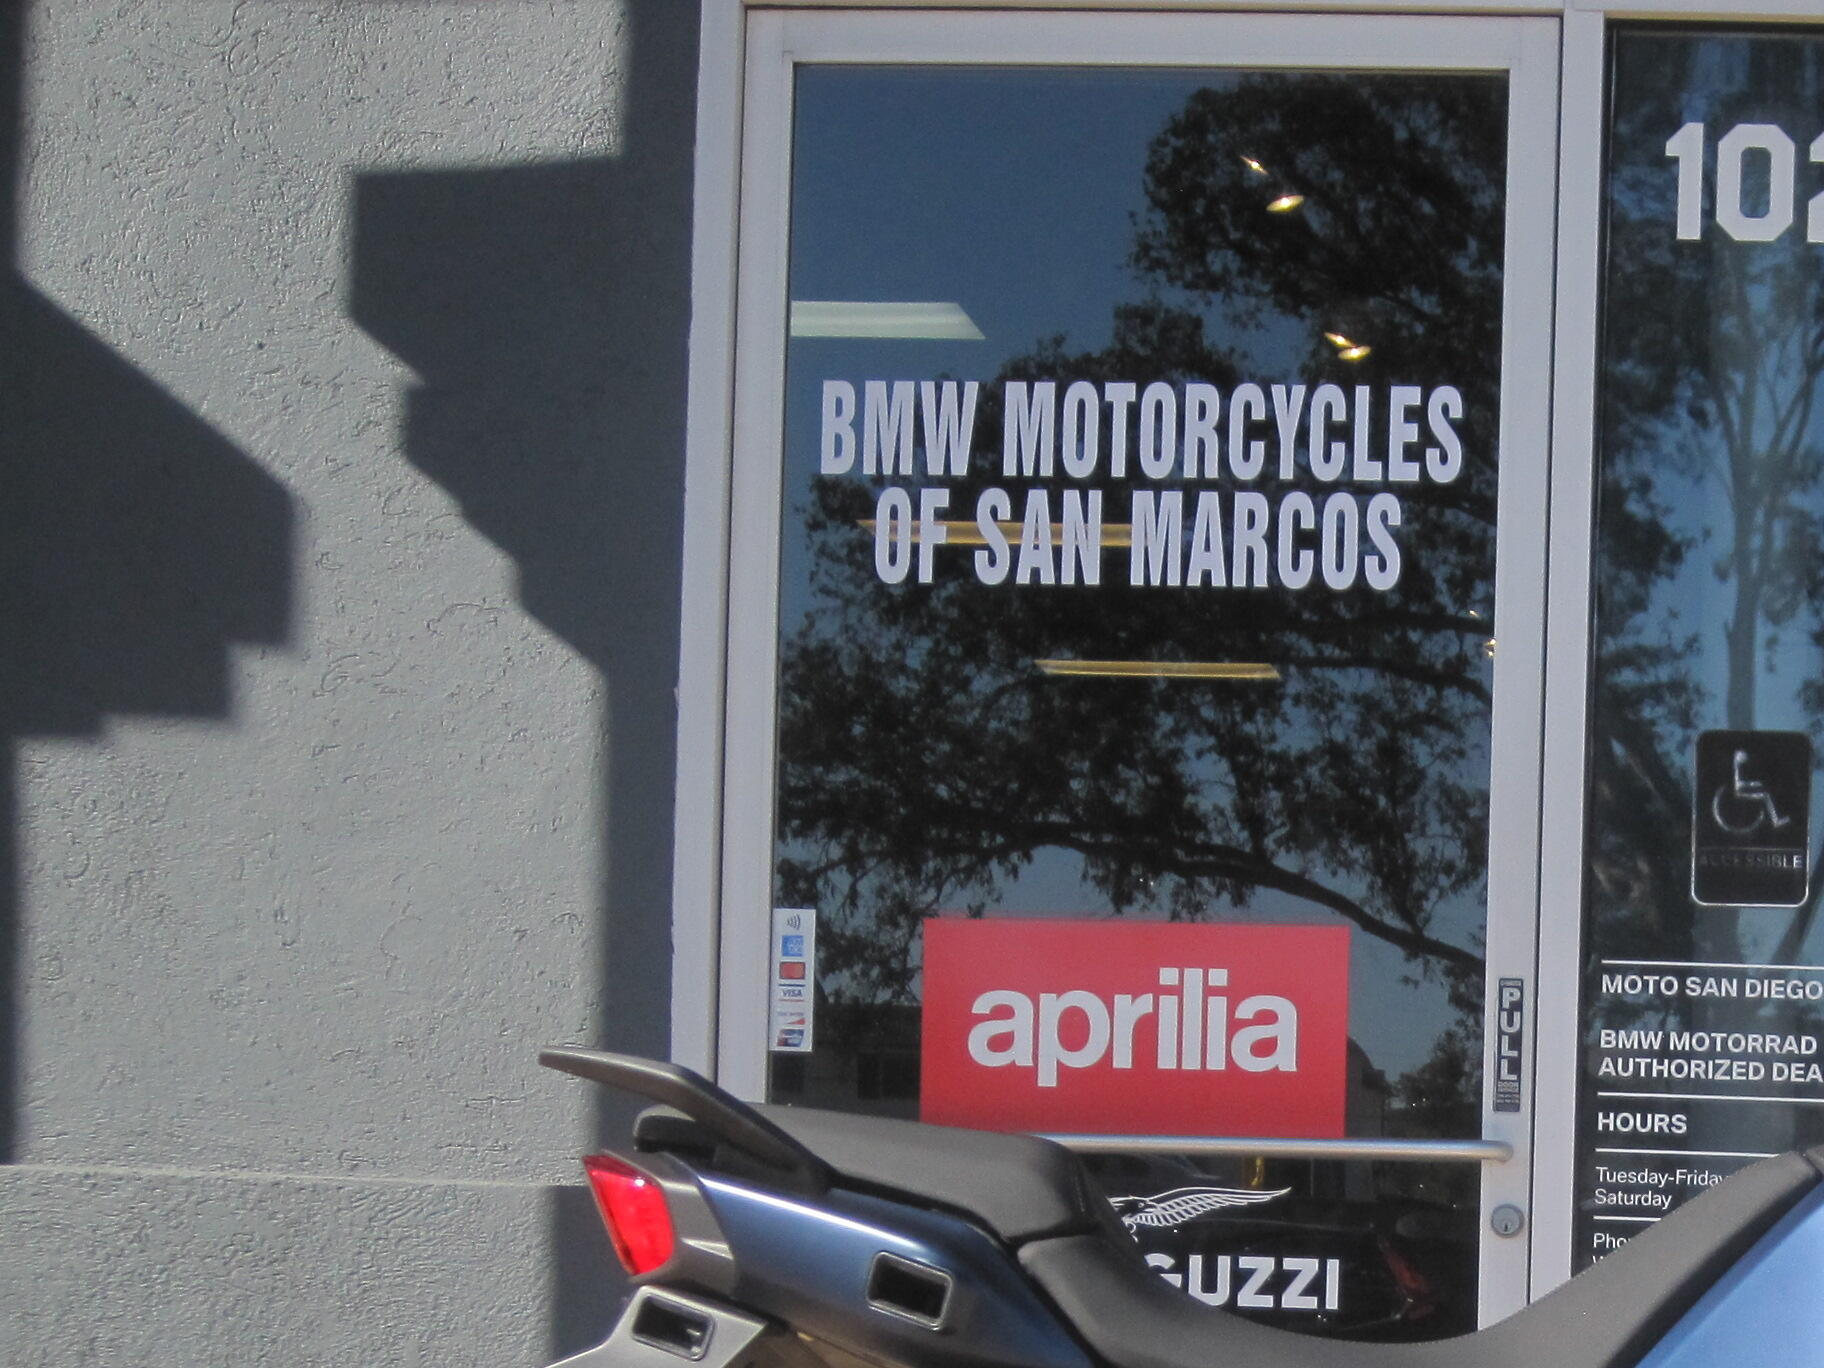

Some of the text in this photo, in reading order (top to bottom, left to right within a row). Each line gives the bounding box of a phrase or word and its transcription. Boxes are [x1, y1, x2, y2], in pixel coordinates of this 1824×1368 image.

[820, 379, 1464, 484] BMW MOTORCYCLES
[874, 486, 1402, 592] OF SAN MARCOS
[1601, 974, 1824, 1000] MOTO SAN DIEGO
[967, 966, 1298, 1087] aprilia
[1500, 986, 1521, 1081] PULL
[1599, 1029, 1818, 1055] BMW MOTORRAD
[1598, 1057, 1765, 1081] AUTHORIZED
[1597, 1111, 1688, 1134] HOURS
[1594, 1188, 1673, 1210] Saturday
